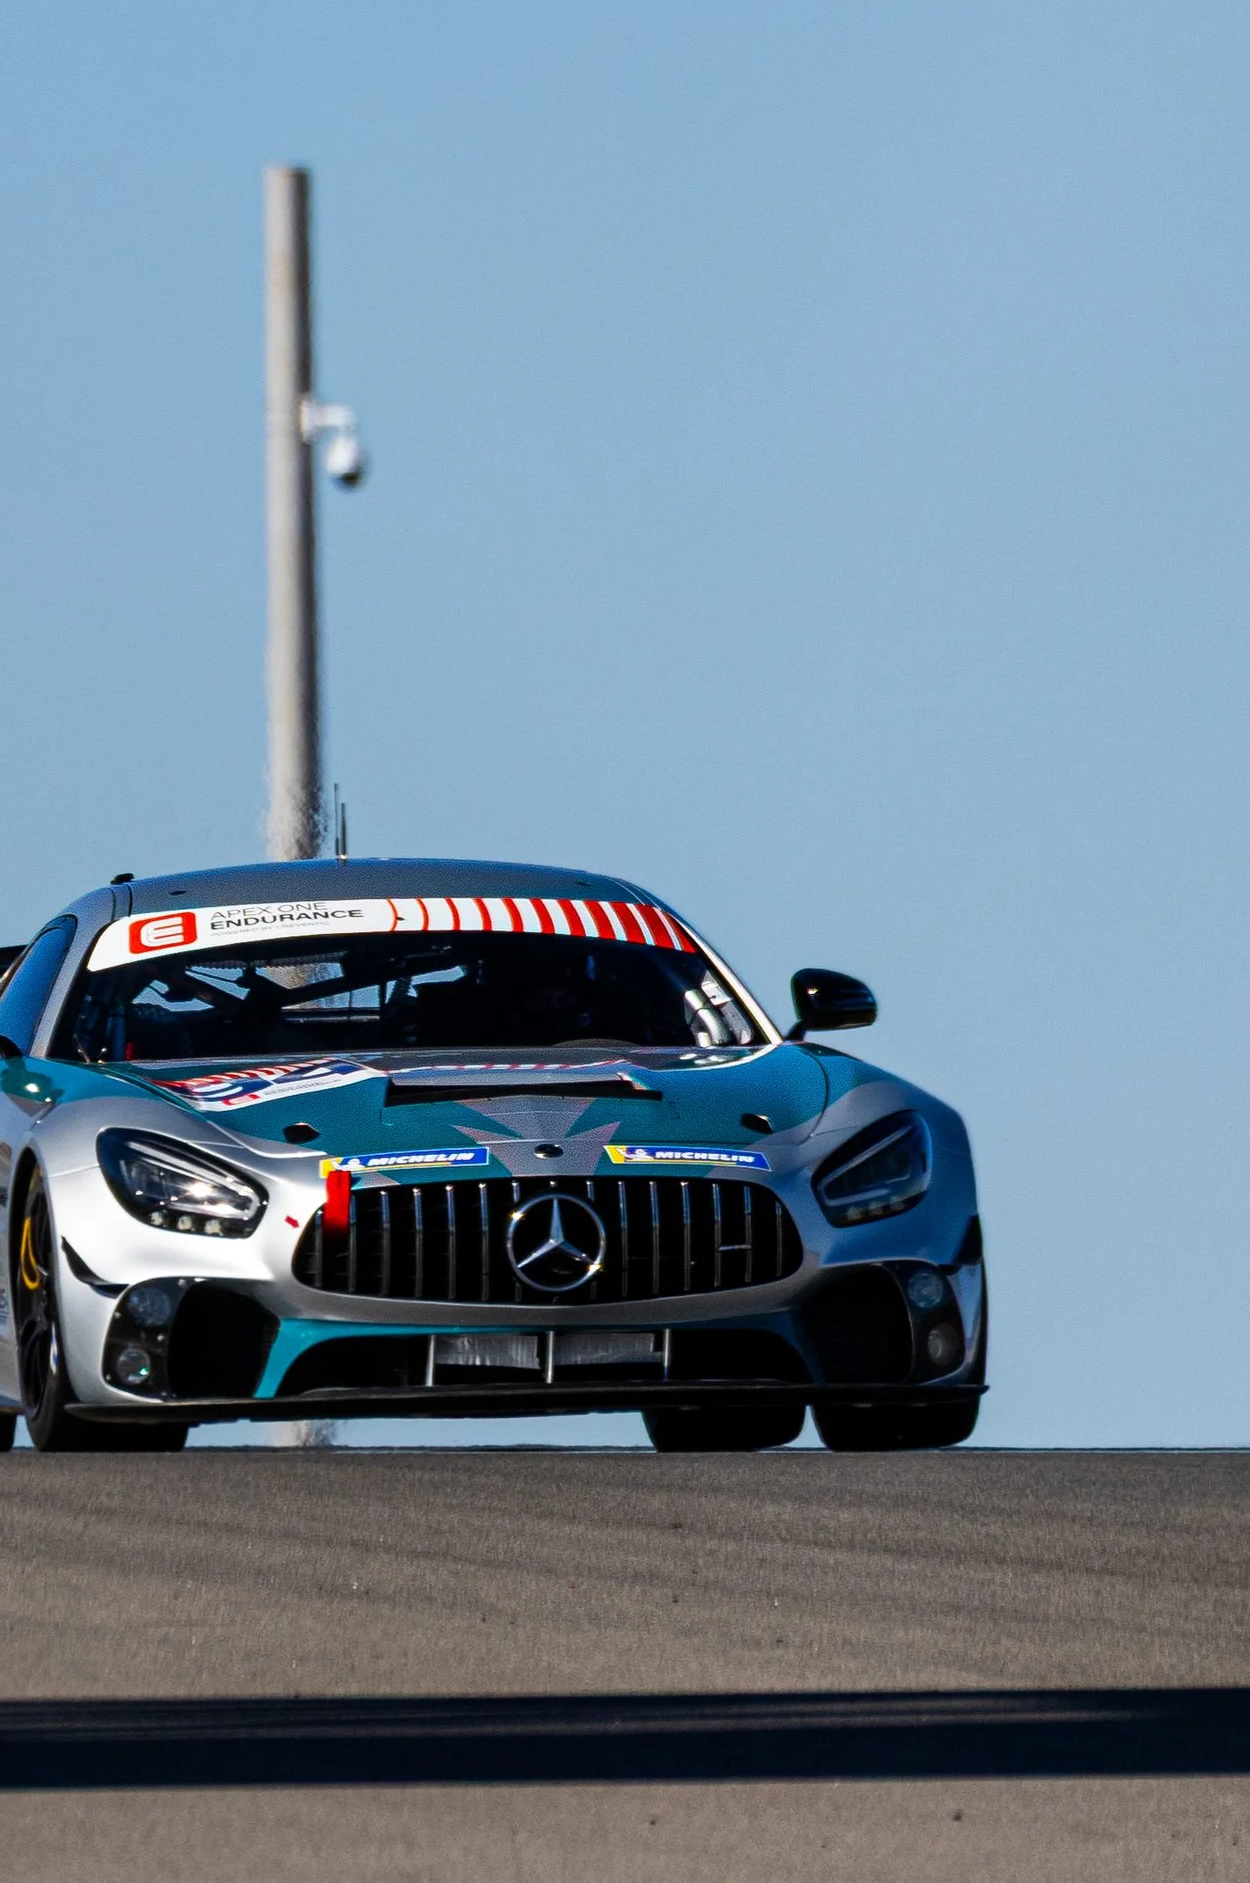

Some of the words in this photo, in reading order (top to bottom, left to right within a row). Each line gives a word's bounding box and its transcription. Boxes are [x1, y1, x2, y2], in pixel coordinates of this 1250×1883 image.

[211, 907, 271, 920] APEX
[277, 902, 328, 913] ONE
[210, 909, 364, 930] ENDURANCE
[367, 1152, 475, 1167] MICHELIN
[654, 1151, 756, 1164] MICHELIN
